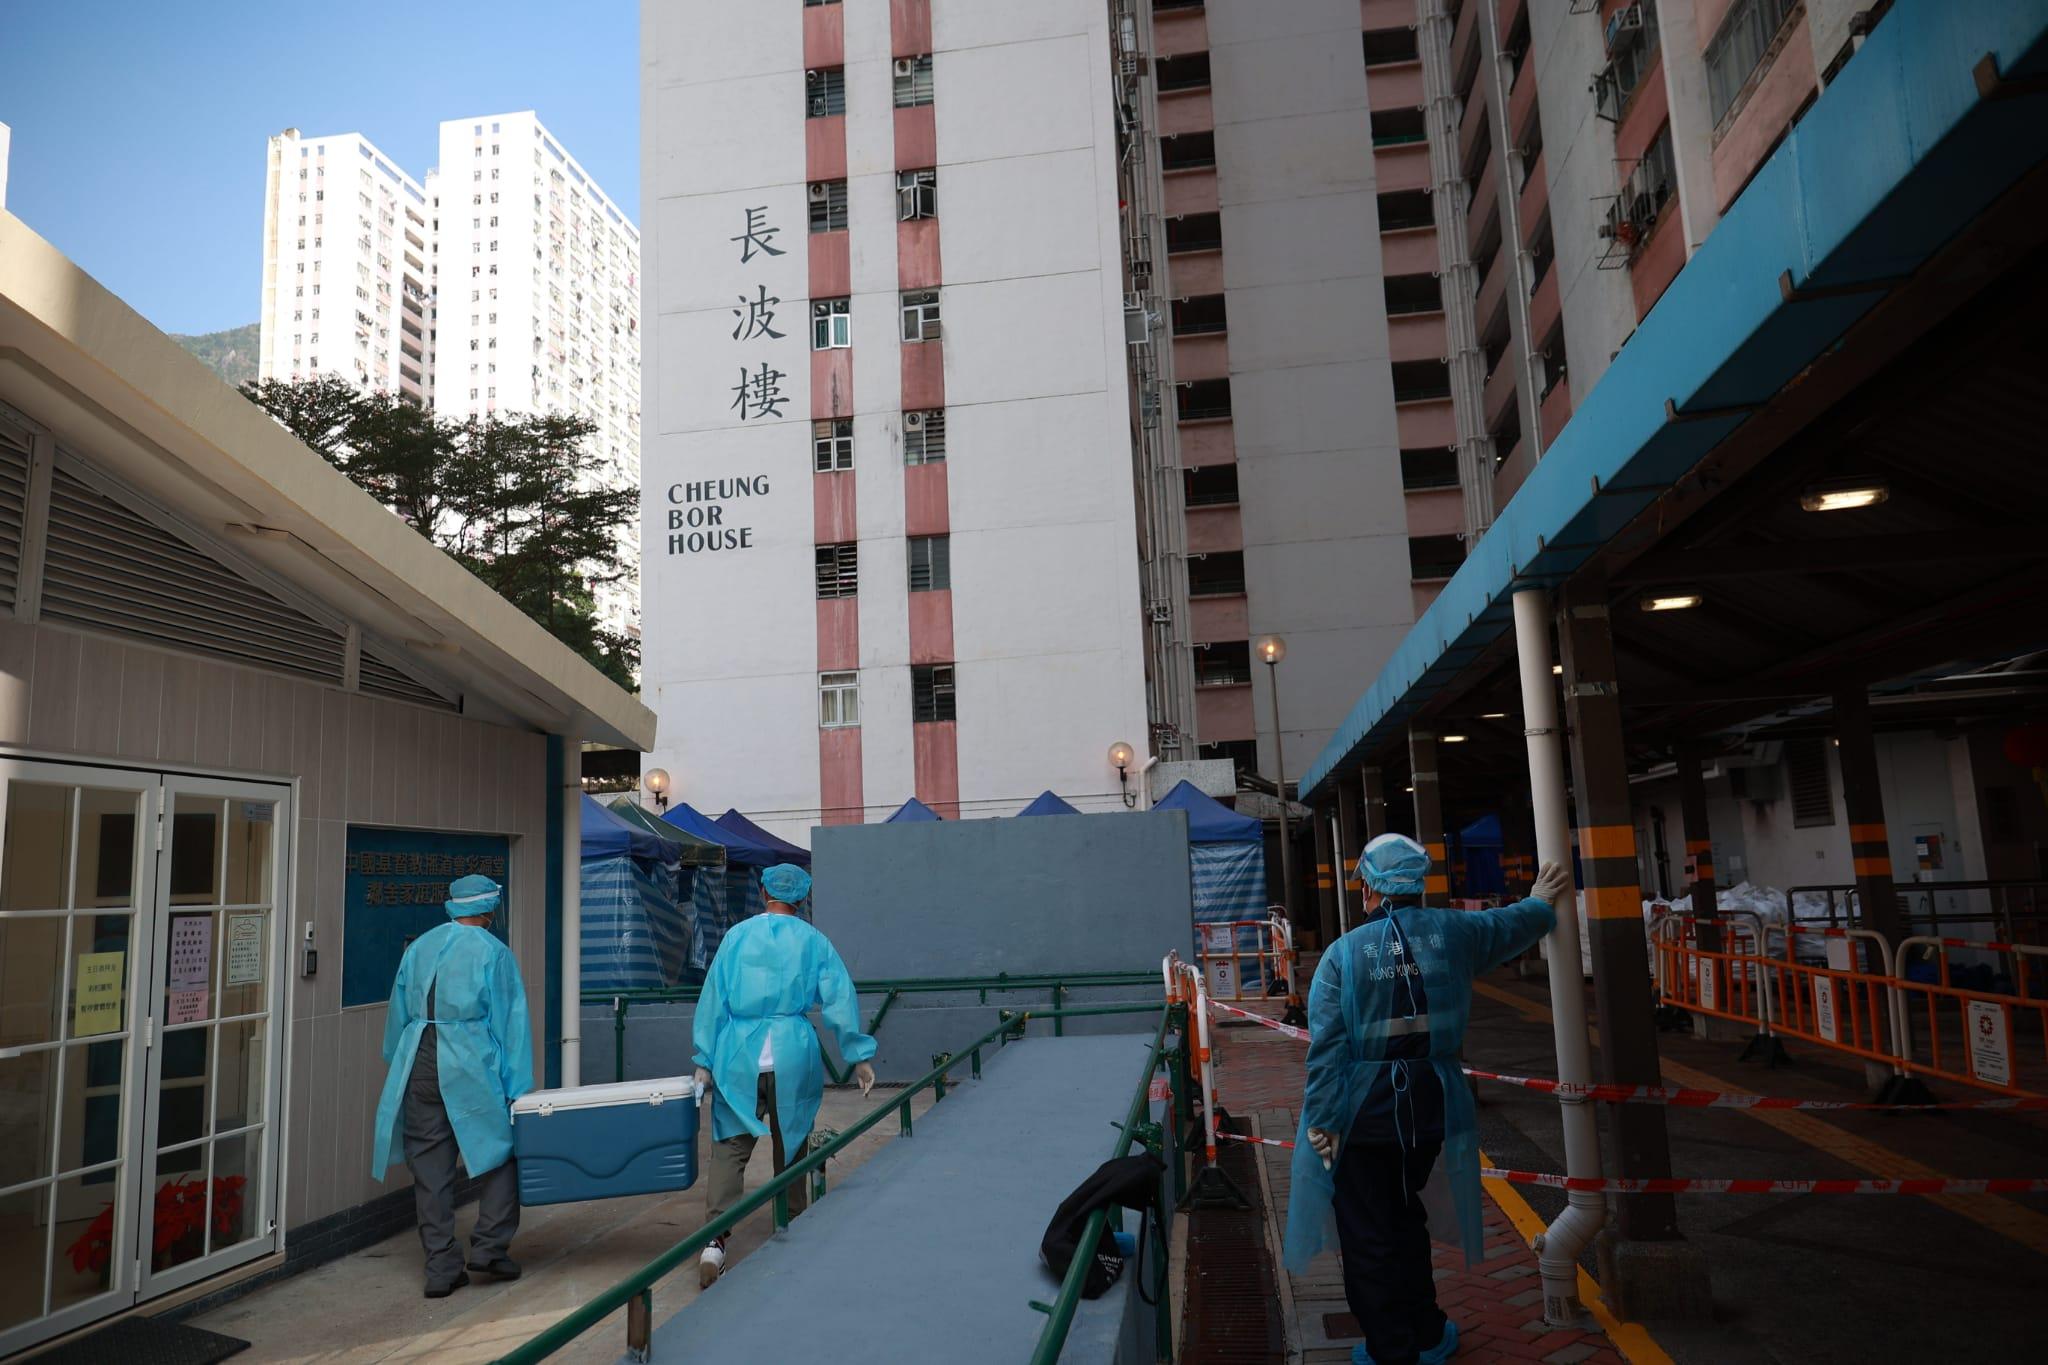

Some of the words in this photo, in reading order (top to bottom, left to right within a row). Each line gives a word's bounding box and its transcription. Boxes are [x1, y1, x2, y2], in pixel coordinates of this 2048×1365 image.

[730, 205, 791, 422] 長波樓
[668, 474, 770, 504] CHEUNG
[668, 505, 723, 530] BOR
[668, 527, 753, 555] HOUSE
[1369, 966, 1395, 981] HONG
[1396, 962, 1419, 977] KONG
